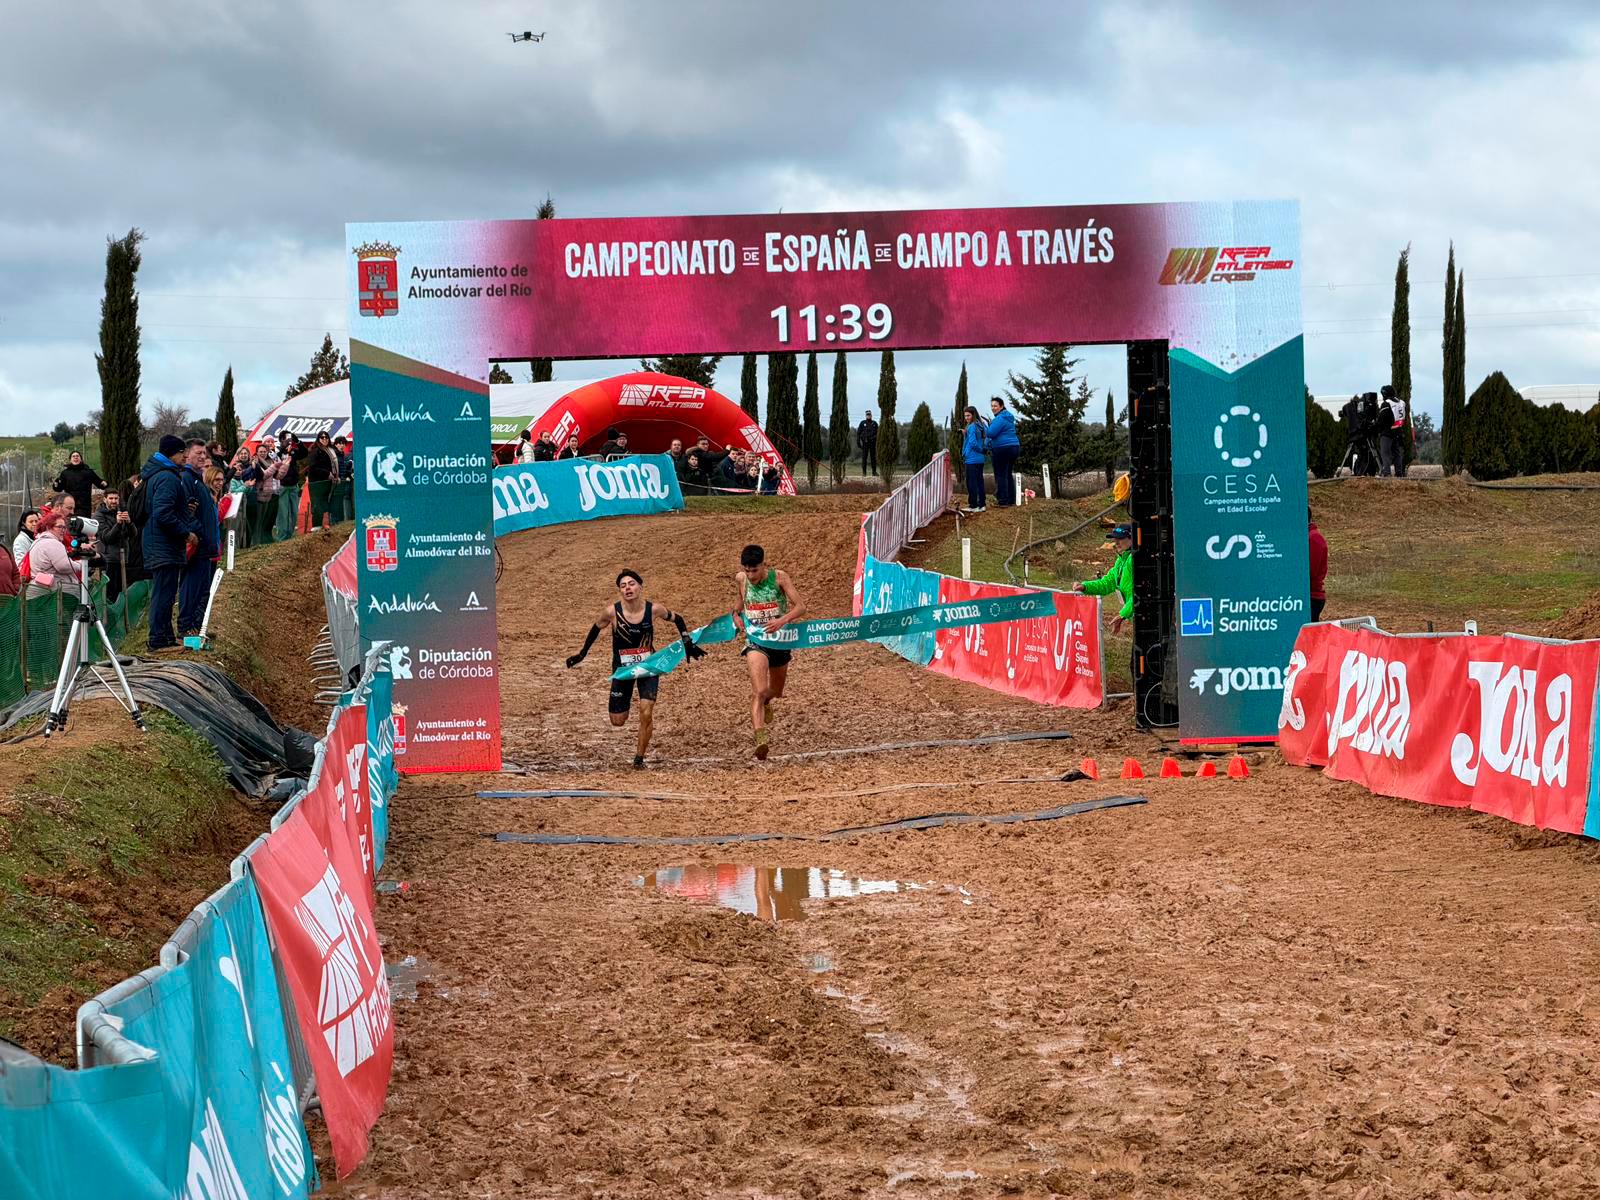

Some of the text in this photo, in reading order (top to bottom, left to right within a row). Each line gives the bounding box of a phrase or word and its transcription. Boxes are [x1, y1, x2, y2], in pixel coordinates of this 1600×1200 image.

[565, 239, 736, 278] CAMPEONATO
[743, 250, 760, 264] DE
[875, 247, 892, 259] DE
[897, 230, 988, 270] CAMPO
[994, 231, 1012, 266] A
[1016, 218, 1115, 266] TRAVÉS
[410, 264, 529, 282] Ayuntamiento de
[1215, 260, 1294, 272] ATLETISMO
[1210, 272, 1256, 284] CROSS
[408, 283, 532, 299] Almodóvar del Río
[769, 302, 894, 343] 11:39
[650, 385, 706, 401] RFEA
[647, 400, 704, 409] ATLETISMO
[361, 402, 437, 424] Andalucía
[413, 453, 487, 471] Diputación
[413, 471, 488, 485] de Córdoba
[1203, 473, 1281, 495] CESA
[1203, 495, 1282, 506] Campeonatos de España
[1226, 505, 1244, 513] Edad
[1244, 504, 1268, 513] Escolar
[409, 530, 487, 545] Ayuntamiento de
[404, 545, 491, 558] Almodóvar del Río
[367, 593, 442, 615] Andalucía
[1219, 596, 1303, 614] Fundación
[806, 619, 860, 633] ALMODÓVAR
[1219, 616, 1278, 632] Sanitas
[808, 630, 859, 643] DEL RÍO 2026
[418, 647, 492, 665] Diputación
[418, 664, 494, 680] de Córdoba
[1214, 666, 1288, 696] Jom
[416, 718, 487, 732] Ayuntamiento de
[412, 730, 491, 743] Almodóvar del Río
